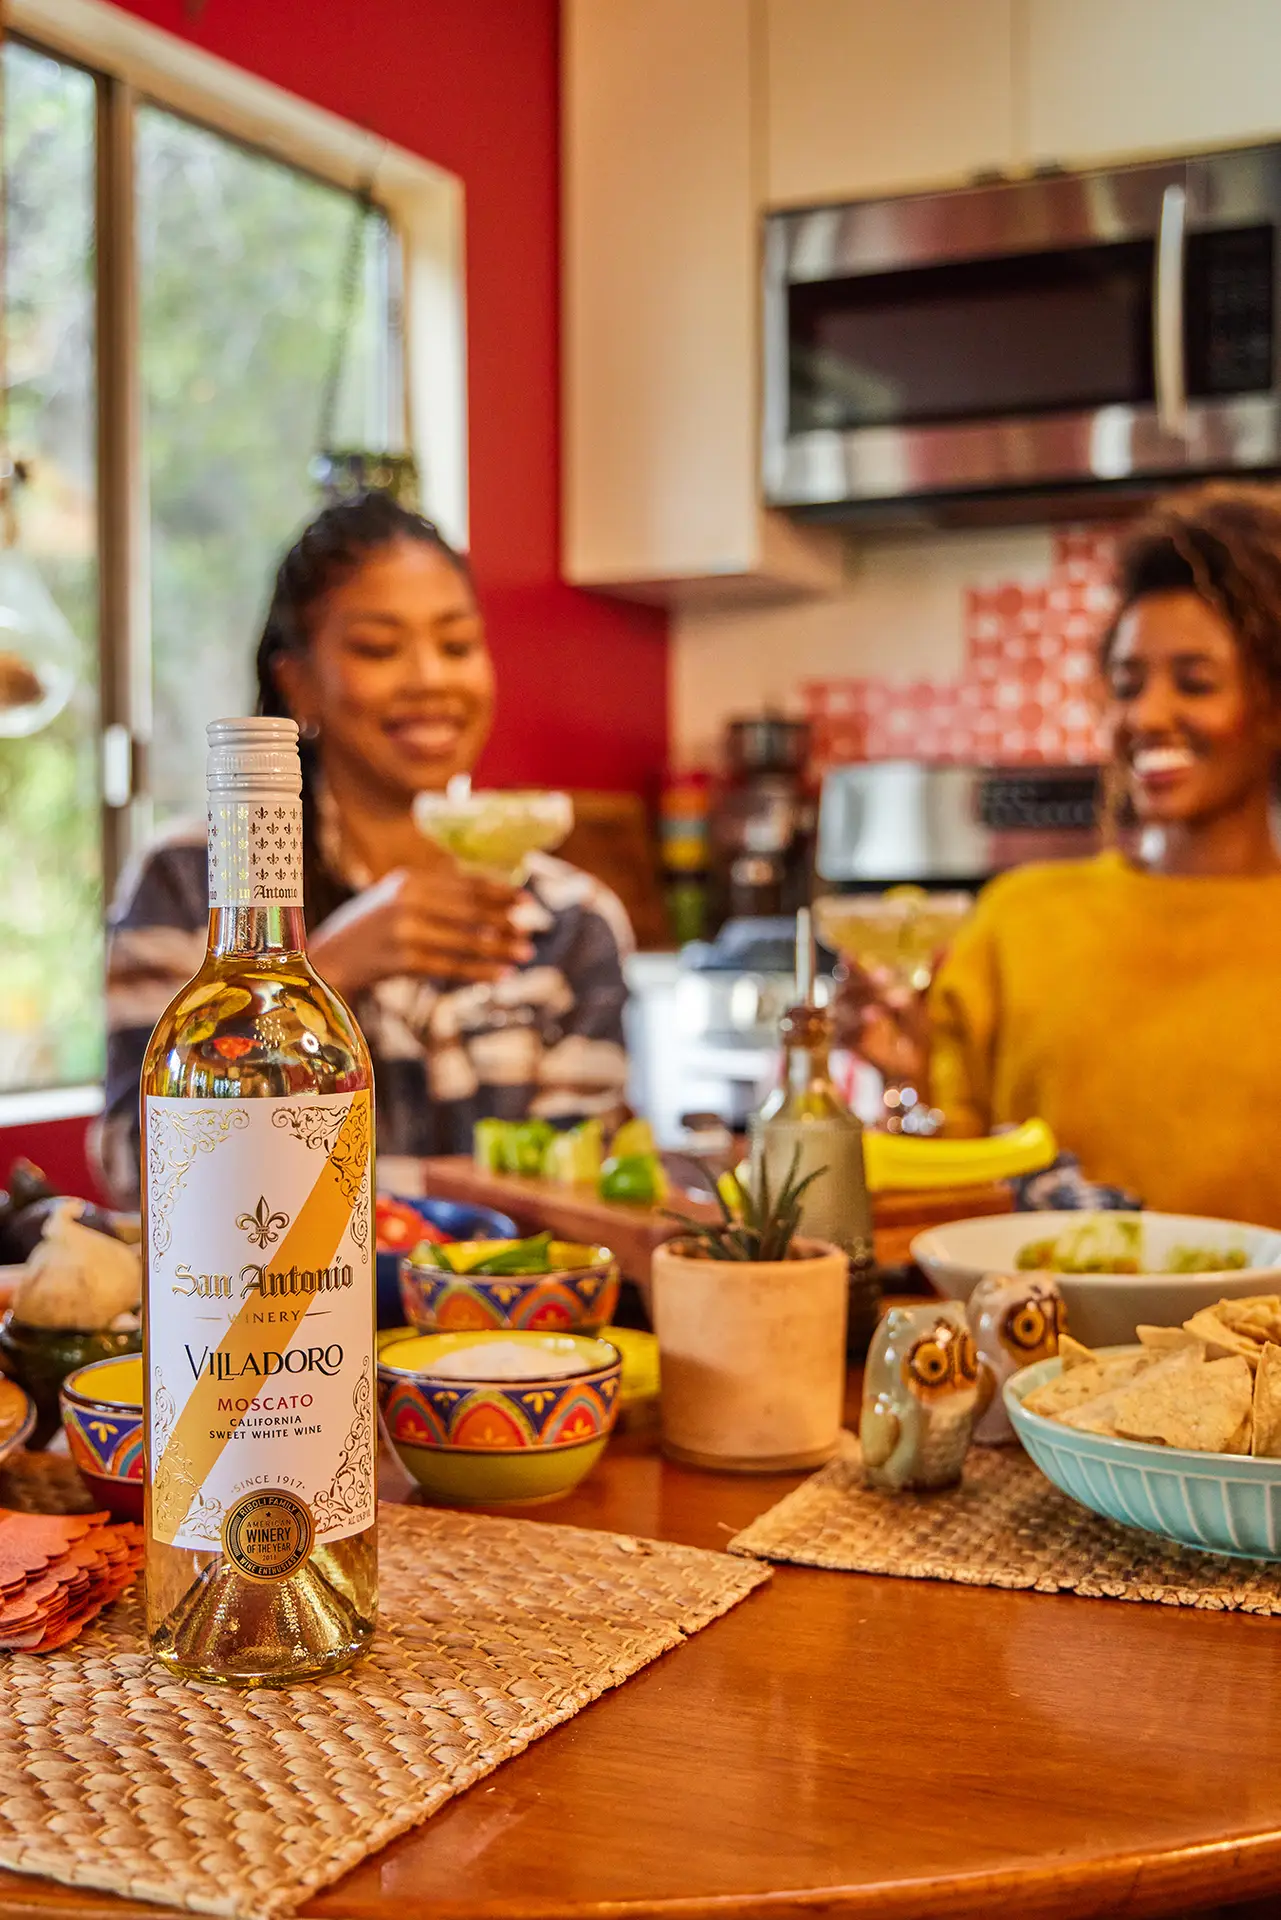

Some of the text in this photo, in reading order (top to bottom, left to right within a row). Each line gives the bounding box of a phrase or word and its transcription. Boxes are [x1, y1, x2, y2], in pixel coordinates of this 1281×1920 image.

[172, 1256, 354, 1299] San Antonio
[228, 1310, 301, 1324] WINERY
[184, 1344, 344, 1381] VILLADORO
[217, 1394, 313, 1411] MOSCATO
[229, 1415, 302, 1427] CALIFORNIA
[209, 1424, 322, 1439] SWEET WHITE WINE
[233, 1474, 302, 1493] SINCE 1917
[239, 1497, 297, 1517] RIBOLI FAMILY
[247, 1519, 291, 1528] AMERICAN
[246, 1527, 291, 1543] WINERY
[246, 1542, 291, 1554] OF THE YEAR
[239, 1553, 299, 1575] WINE ENTHUSIAST
